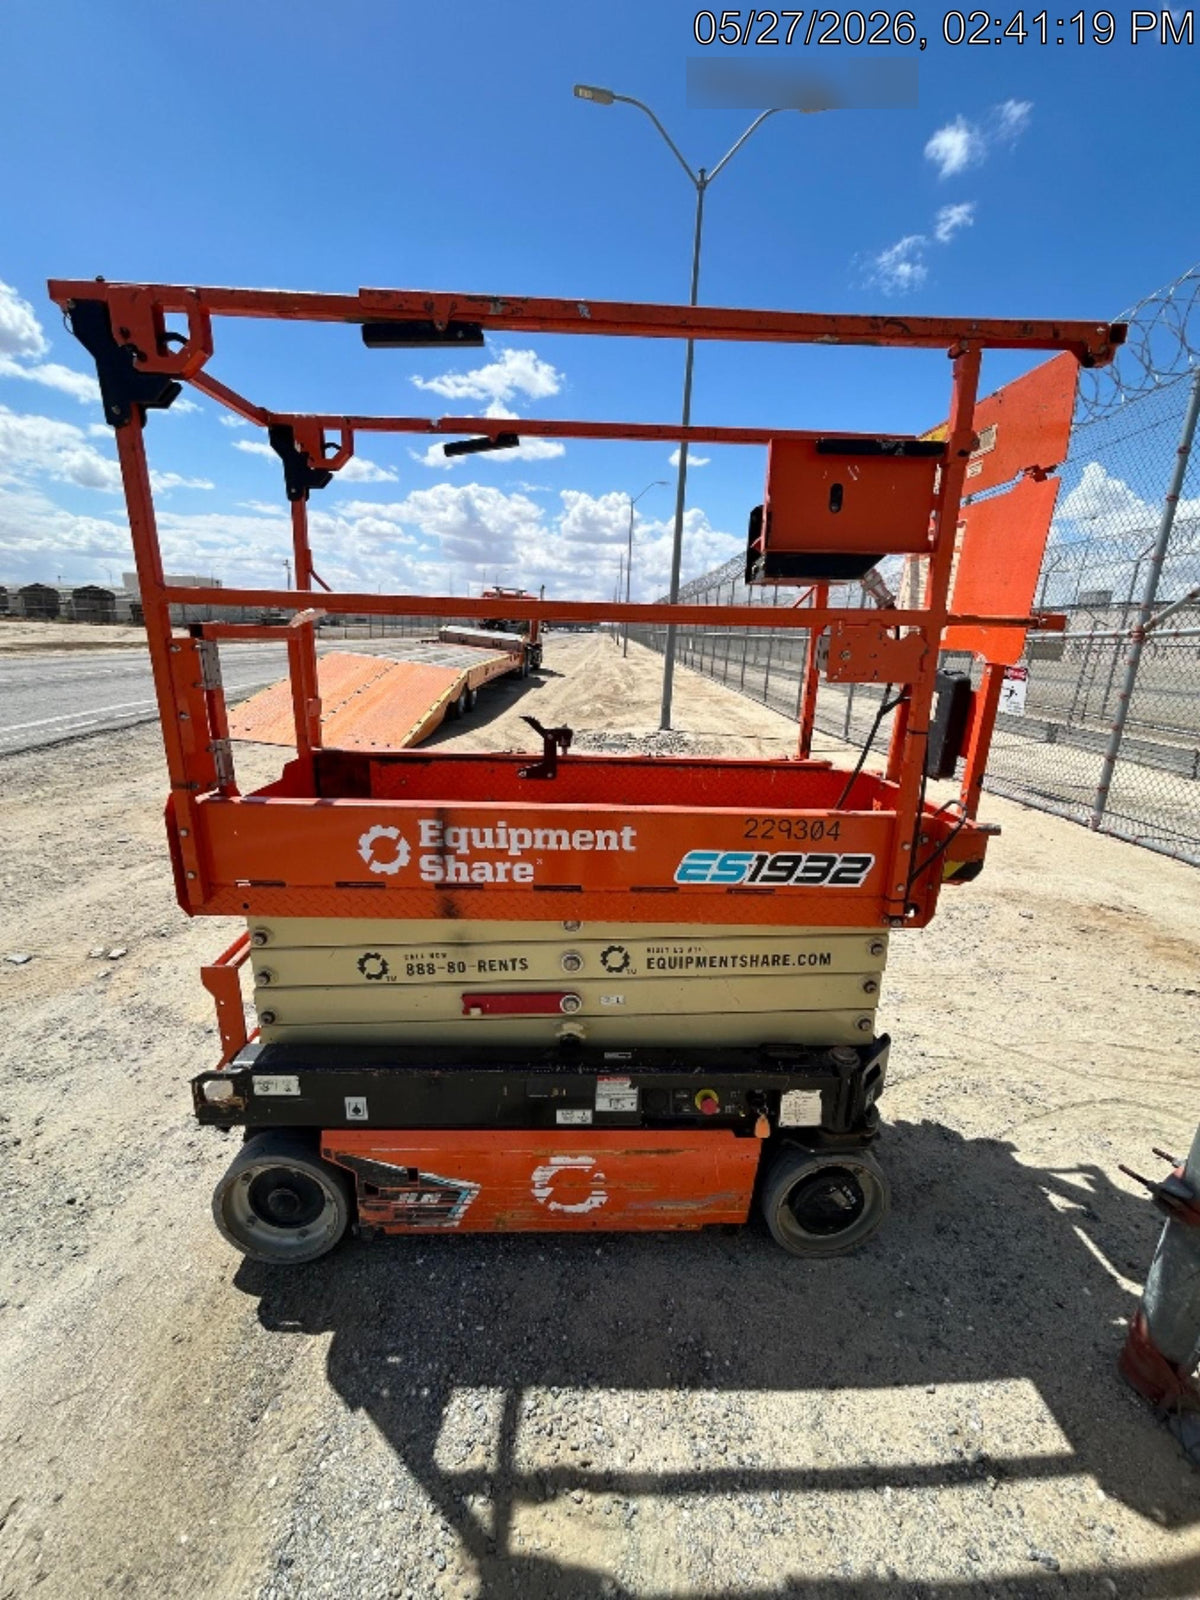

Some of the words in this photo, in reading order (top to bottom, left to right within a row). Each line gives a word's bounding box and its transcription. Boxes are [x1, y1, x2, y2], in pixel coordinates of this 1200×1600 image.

[418, 818, 638, 856] Equipment
[743, 818, 841, 841] 229304
[418, 853, 535, 884] Share
[674, 850, 875, 887] ES1932
[646, 953, 832, 970] EQUIPMENTSHARE.COM
